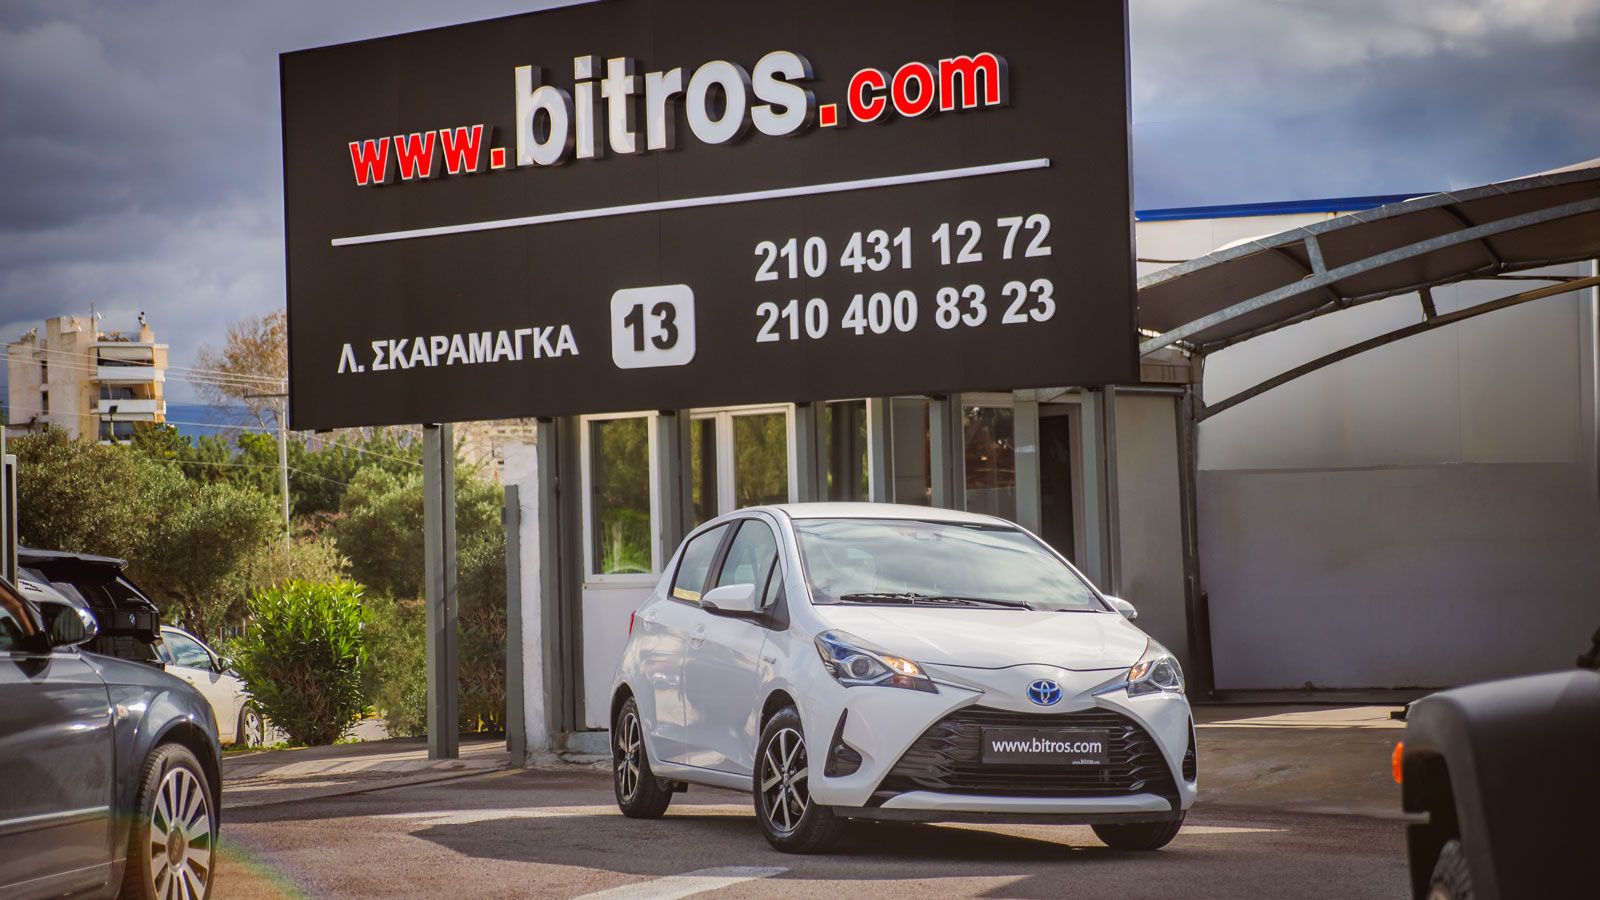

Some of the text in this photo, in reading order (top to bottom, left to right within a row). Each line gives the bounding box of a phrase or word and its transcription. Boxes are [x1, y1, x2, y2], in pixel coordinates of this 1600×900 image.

[349, 51, 1003, 187] www.bitros.com
[754, 213, 1053, 282] 210 431 12 72
[623, 301, 680, 353] 13
[755, 278, 1057, 343] 210 400 83 23
[337, 324, 580, 374] Λ. ΣΚΑΡΑΜΑΓΚΑ
[991, 737, 1102, 754] www.bitros.com
